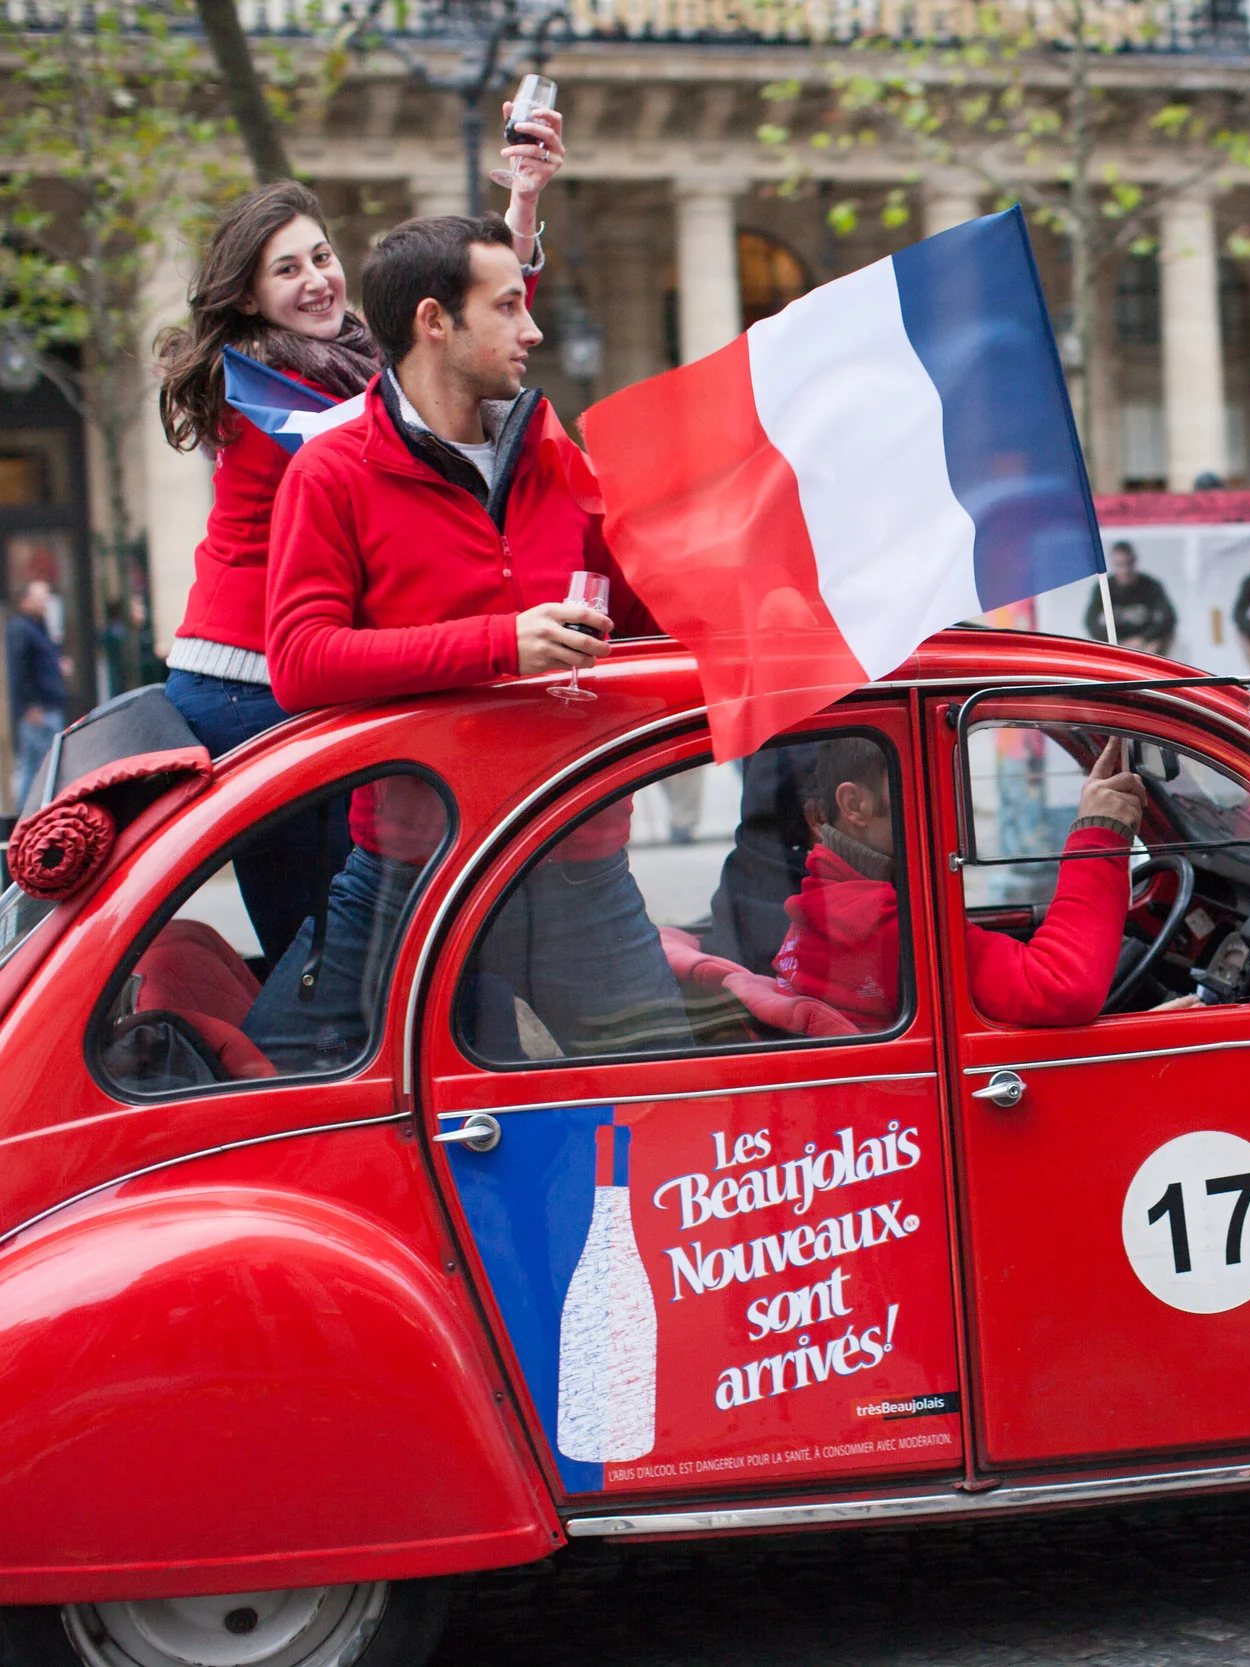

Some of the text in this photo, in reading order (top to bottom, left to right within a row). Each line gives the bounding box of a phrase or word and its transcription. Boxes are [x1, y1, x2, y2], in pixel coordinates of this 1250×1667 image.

[653, 1119, 921, 1230] Beaujolais
[711, 1128, 772, 1171] Les
[746, 1266, 854, 1341] sont
[714, 1303, 899, 1411] arrivés!
[856, 1397, 945, 1417] trèsBeaujolais
[608, 1469, 635, 1482] L'ABUS
[637, 1463, 677, 1478] D'ALCOOL
[679, 1461, 694, 1475] EST
[696, 1456, 745, 1473] DANGEREUX
[747, 1453, 769, 1467] POUR
[772, 1452, 783, 1464] LA
[823, 1442, 875, 1459] CONSOMMER
[876, 1438, 897, 1451] AVEC
